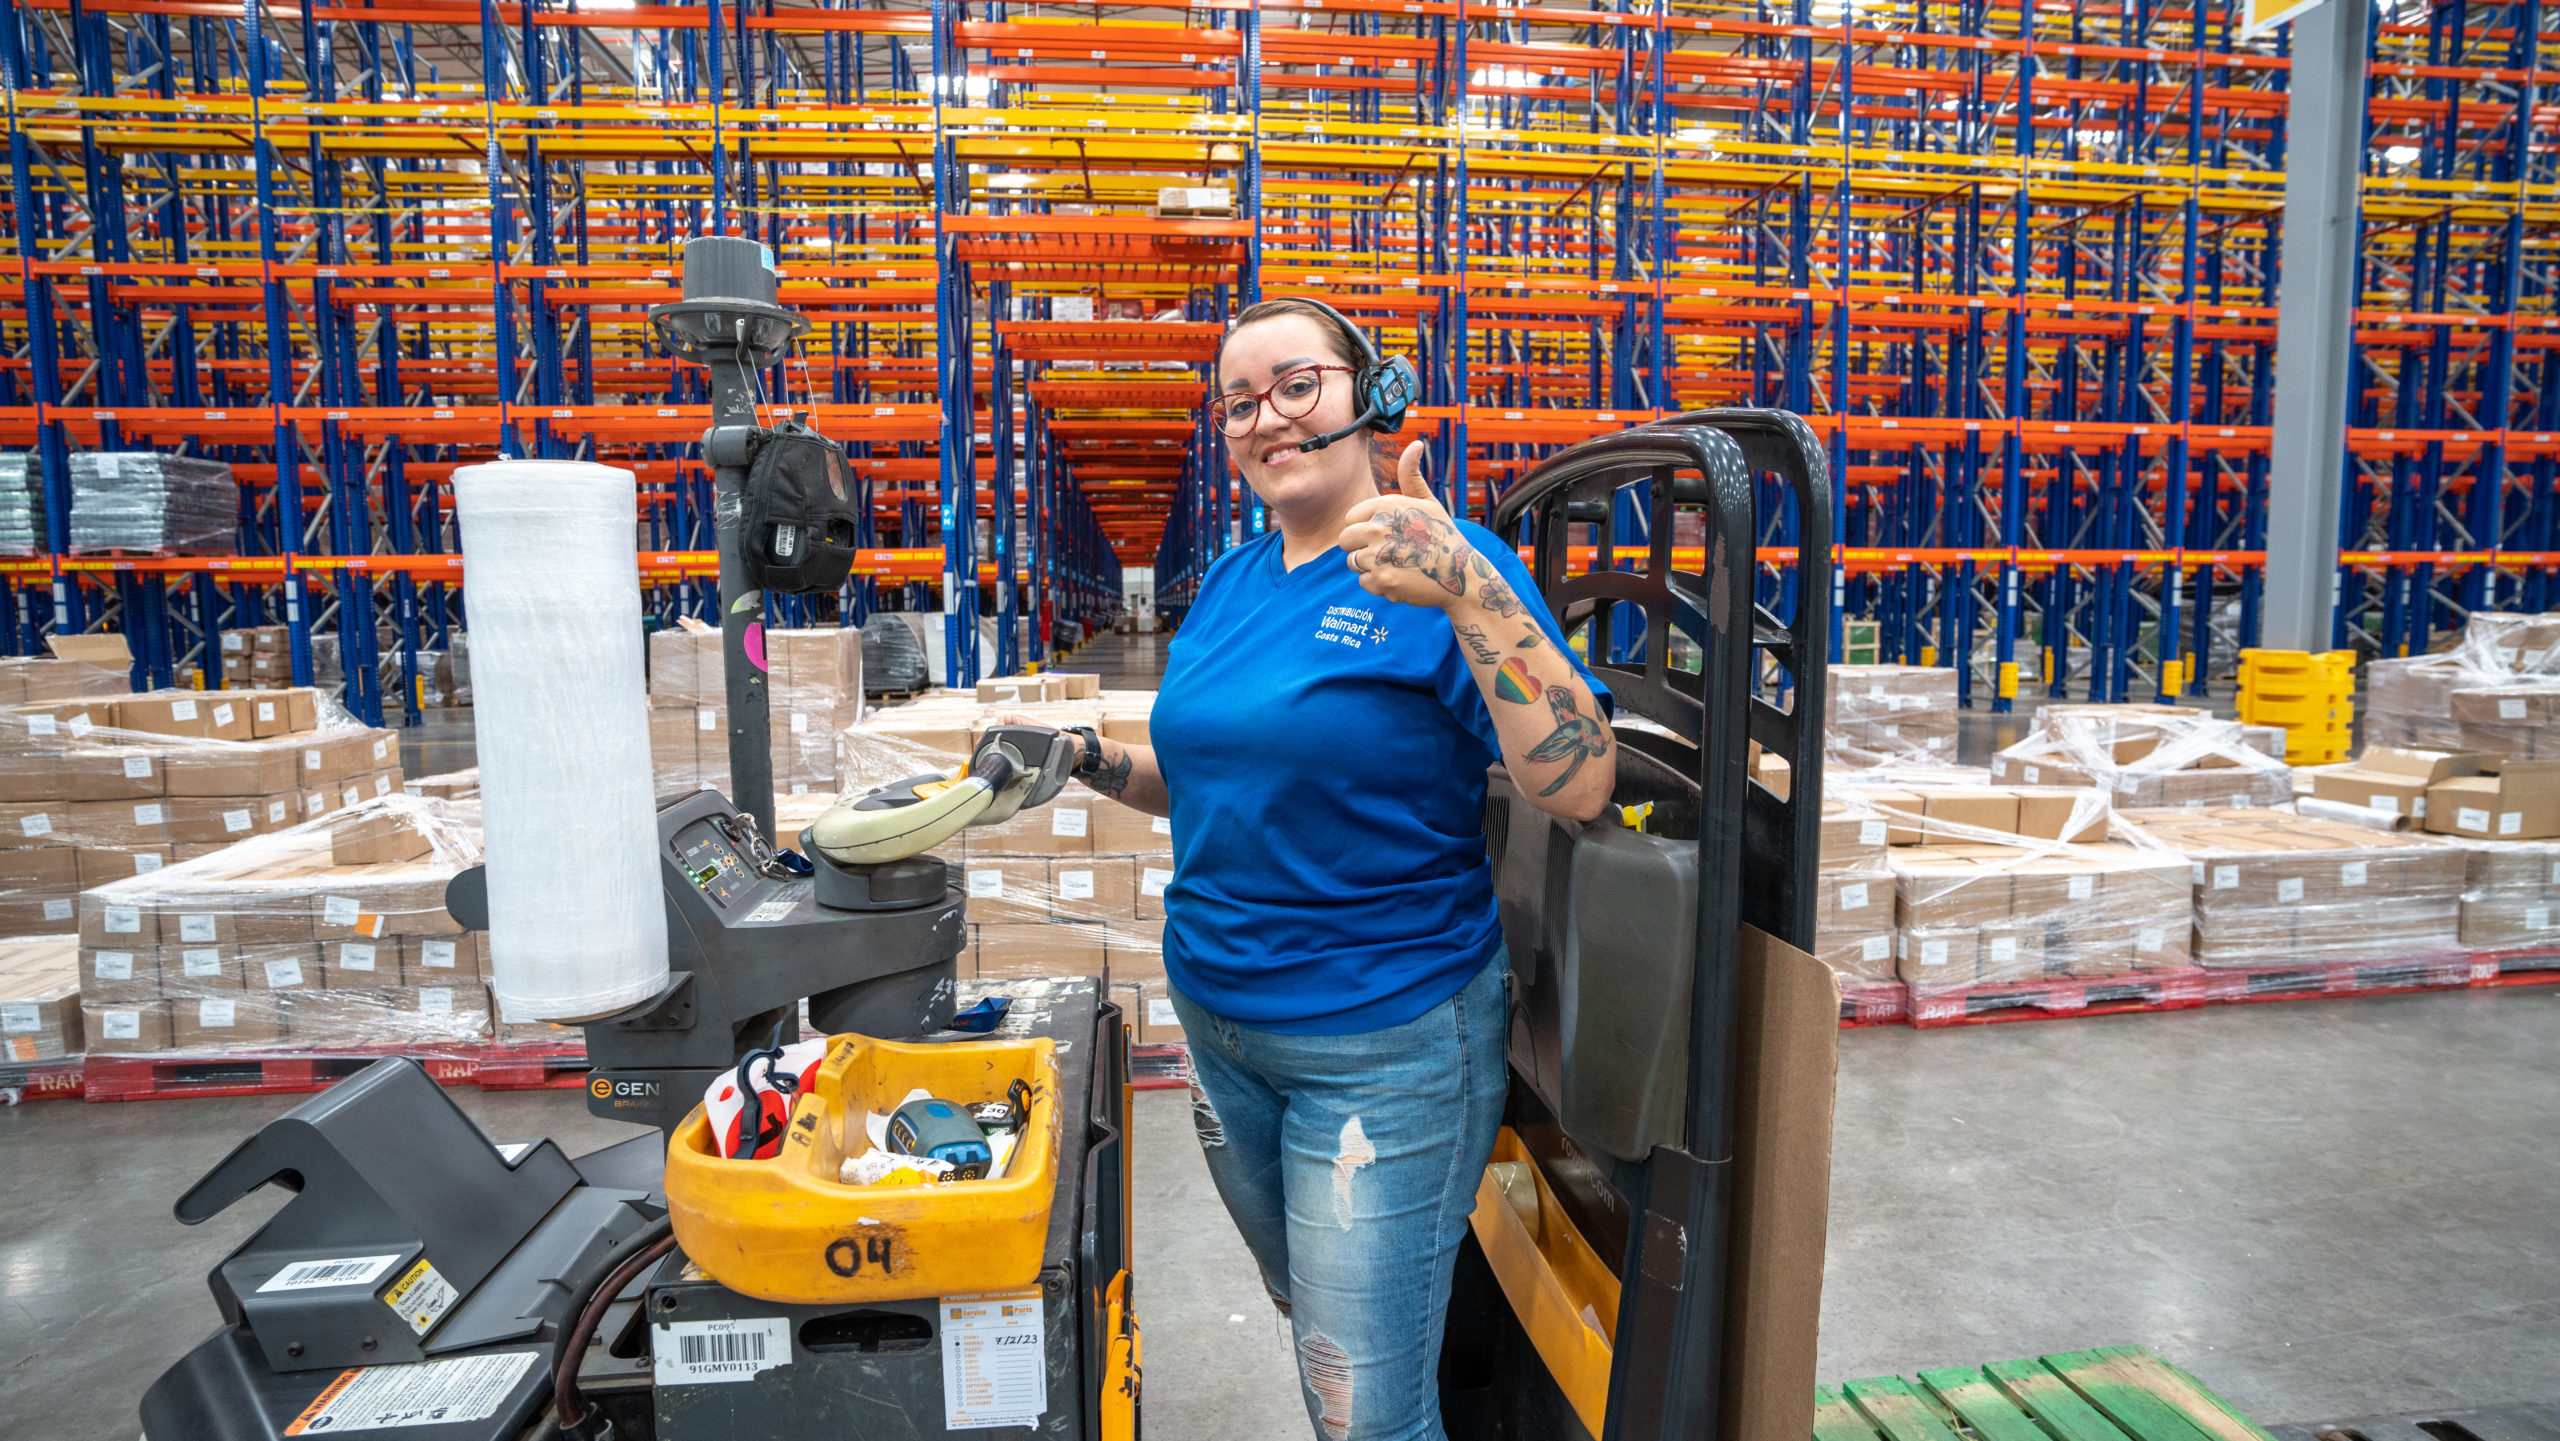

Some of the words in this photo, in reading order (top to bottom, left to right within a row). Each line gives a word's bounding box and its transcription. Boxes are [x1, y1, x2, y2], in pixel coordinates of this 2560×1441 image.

[1326, 605, 1374, 623] DISTRIBUCIÓN
[1321, 615, 1368, 636] Walmart
[1315, 630, 1339, 643] Costa
[1341, 635, 1361, 648] Rica
[438, 1062, 479, 1078] RAP
[40, 1073, 83, 1091] RAP
[615, 1082, 659, 1096] GEN
[825, 1237, 891, 1278] 04
[401, 1267, 424, 1290] CAUTION
[994, 1334, 1038, 1346] 7/2/23
[689, 1362, 758, 1374] 91GMY0113
[310, 1374, 354, 1411] WARNING
